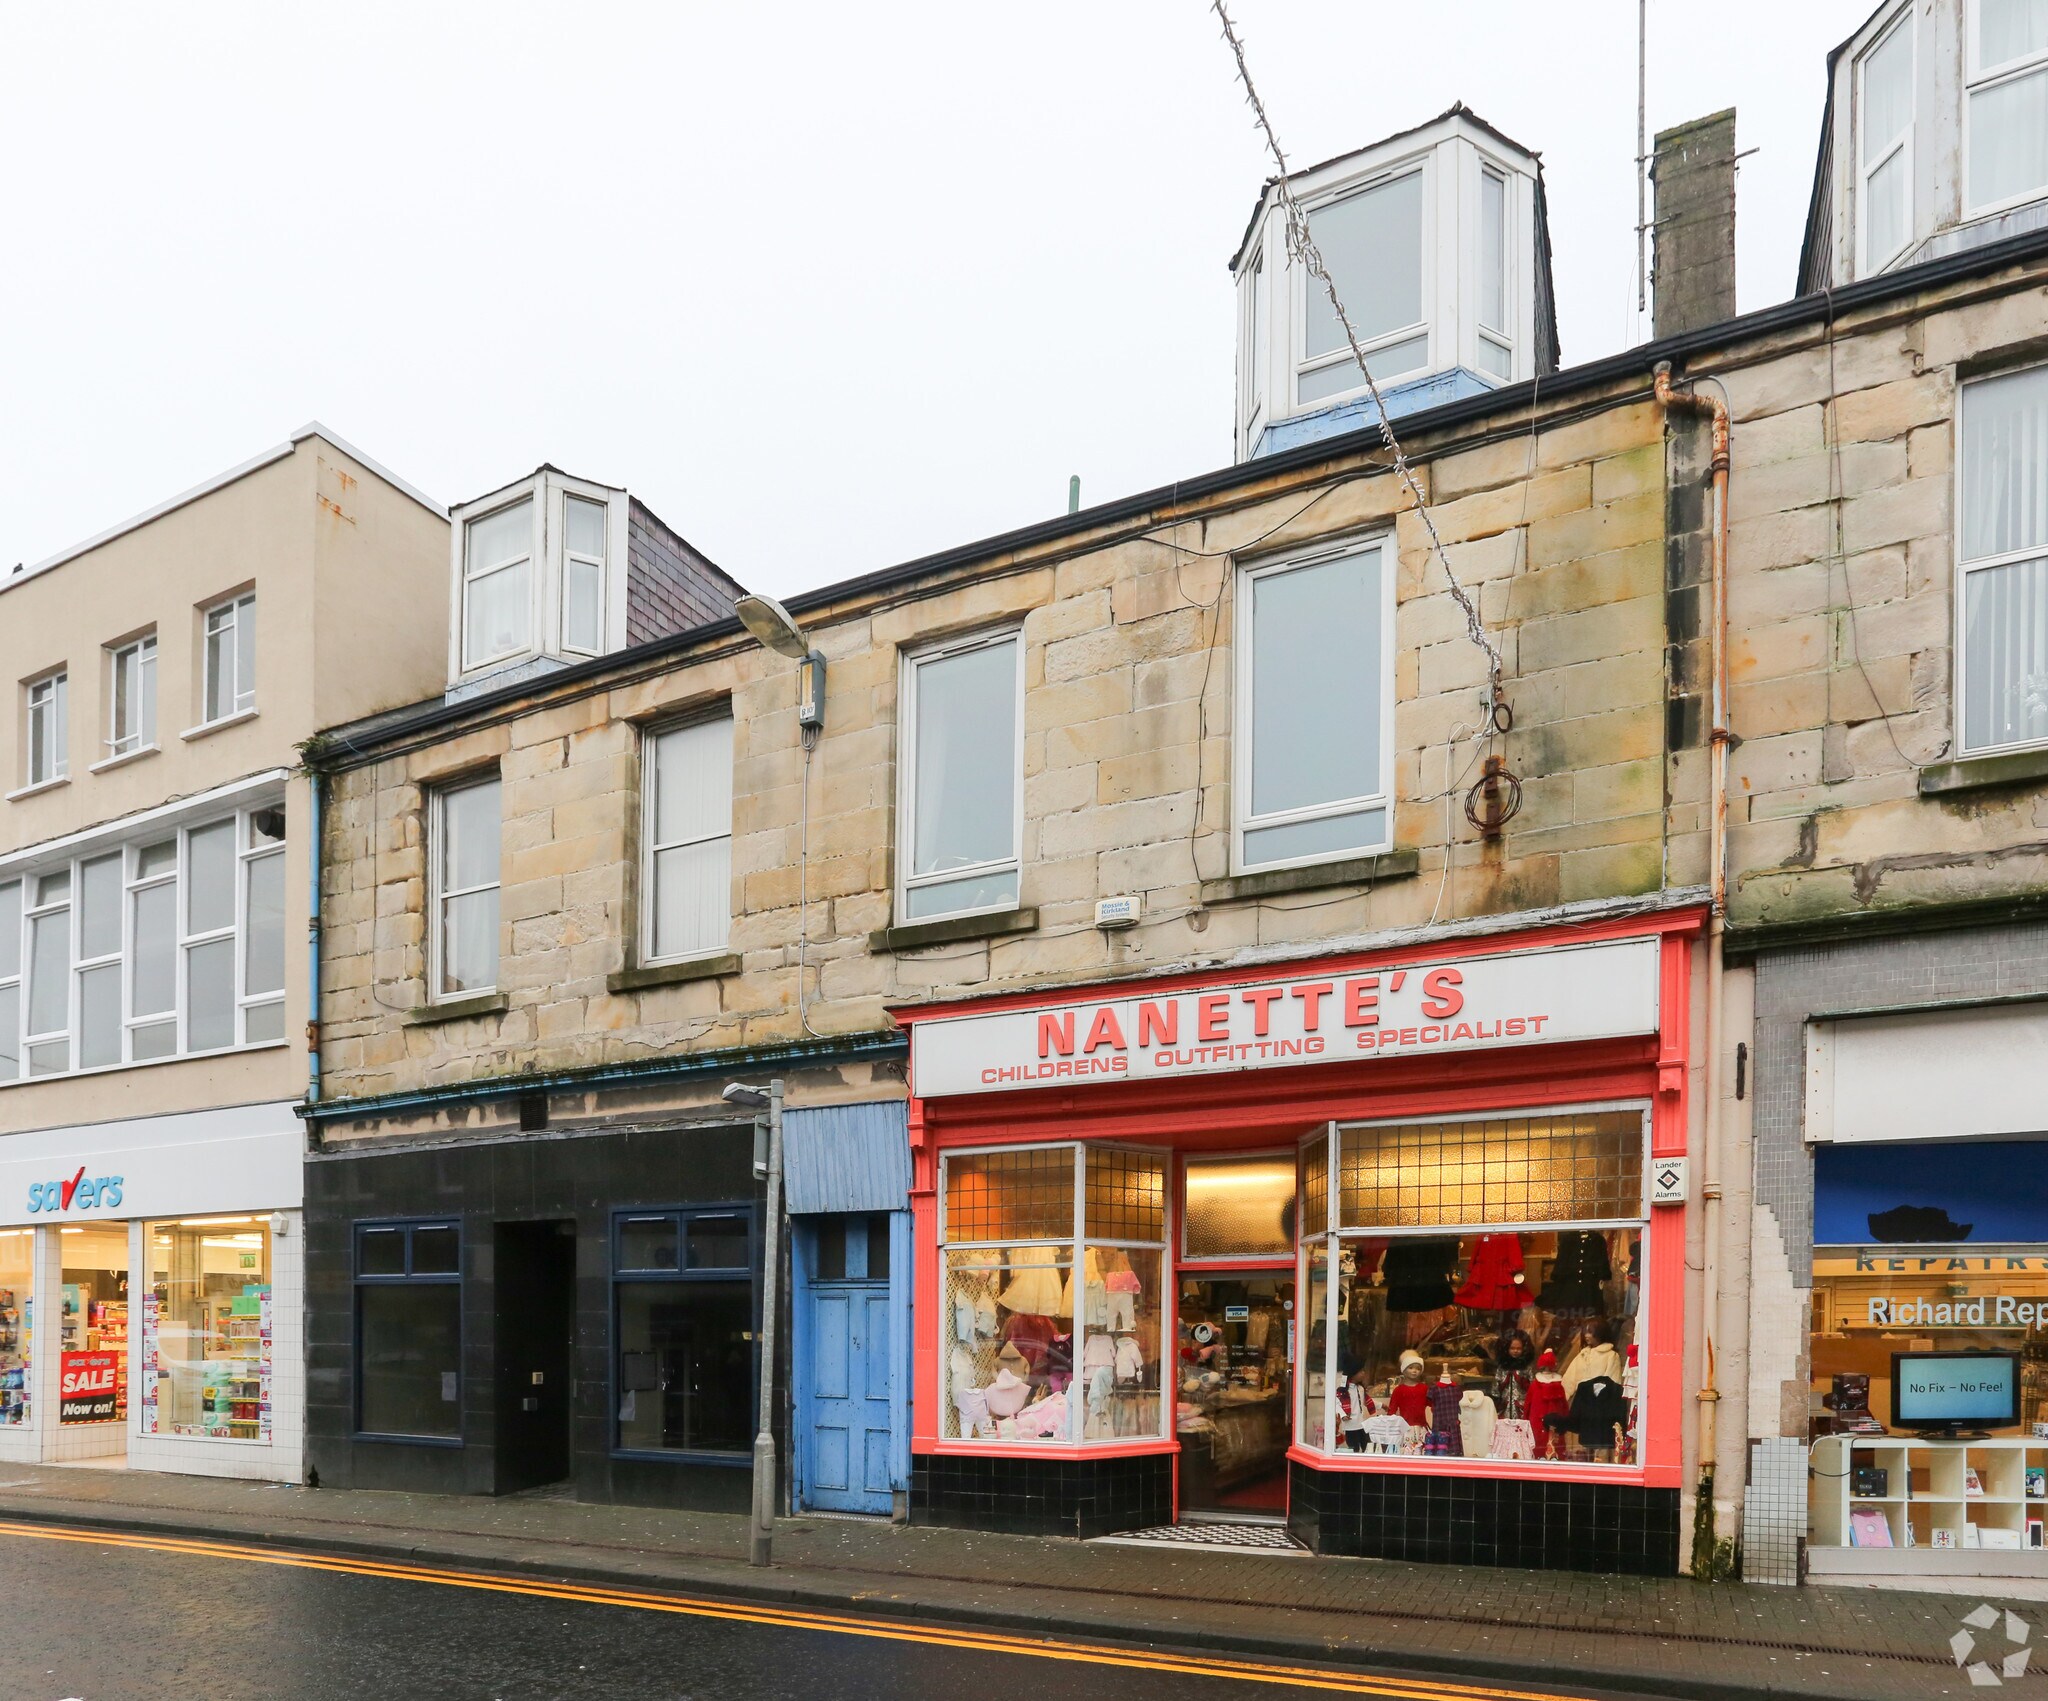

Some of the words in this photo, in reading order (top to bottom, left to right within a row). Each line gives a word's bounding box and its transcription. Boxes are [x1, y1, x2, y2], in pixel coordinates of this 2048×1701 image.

[1102, 906, 1130, 914] Kirkland
[1037, 967, 1464, 1059] NANETTE'S
[981, 1055, 1128, 1084] CHILDRENS
[1154, 1036, 1326, 1067] OUTFITTING
[1356, 1015, 1549, 1049] SPECIALIST
[26, 1166, 124, 1213] savers
[1868, 1296, 1985, 1326] Richard
[1995, 1295, 2048, 1332] Rep
[62, 1369, 116, 1393] SALE
[1910, 1384, 1926, 1393] No
[1929, 1383, 1945, 1393] Fix
[1960, 1383, 1976, 1393] No
[1979, 1382, 2003, 1393] Fee!
[63, 1403, 92, 1416] Now
[93, 1401, 113, 1414] on!
